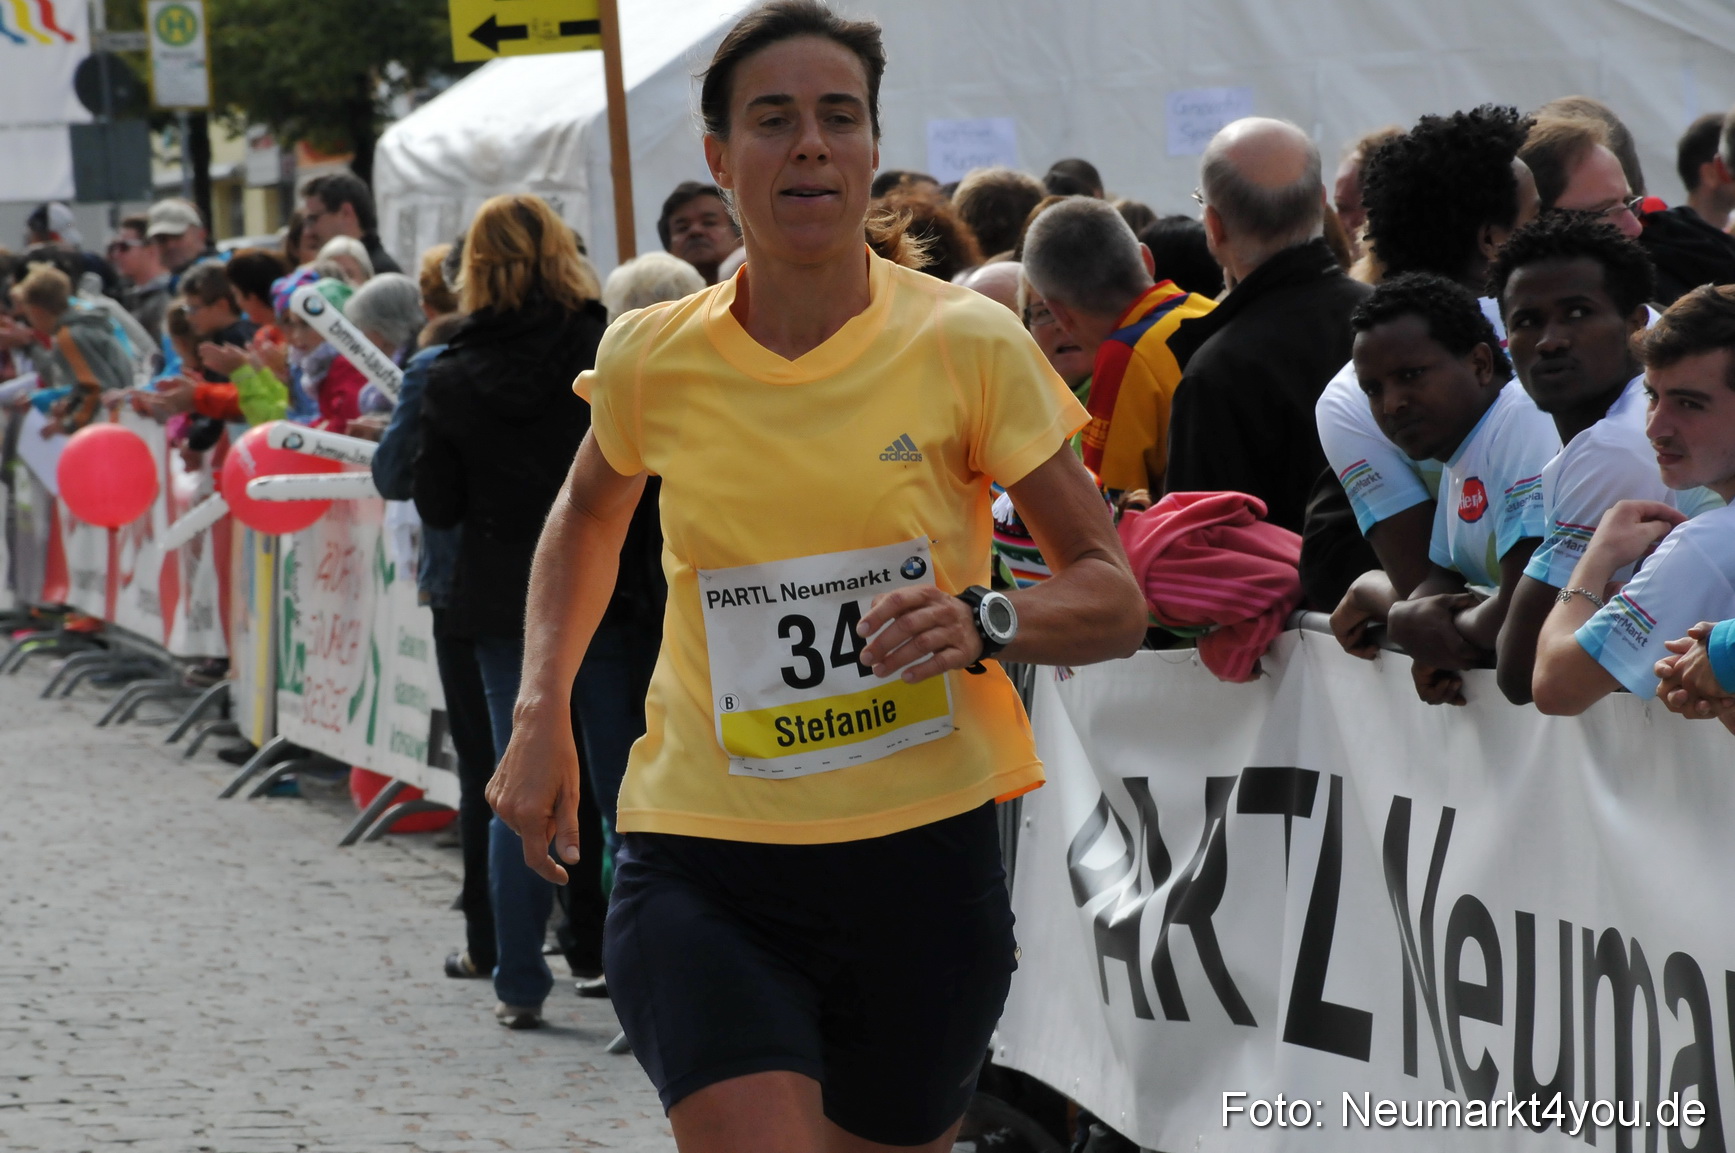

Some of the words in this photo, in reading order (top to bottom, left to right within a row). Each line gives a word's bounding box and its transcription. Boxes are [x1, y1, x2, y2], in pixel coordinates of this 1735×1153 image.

[879, 450, 923, 462] adidas
[707, 585, 777, 609] PARTL
[780, 569, 891, 602] Neumarkt
[778, 600, 873, 689] 34
[725, 696, 734, 710] B
[774, 698, 897, 748] Stefanie
[1383, 794, 1735, 1153] Neuma
